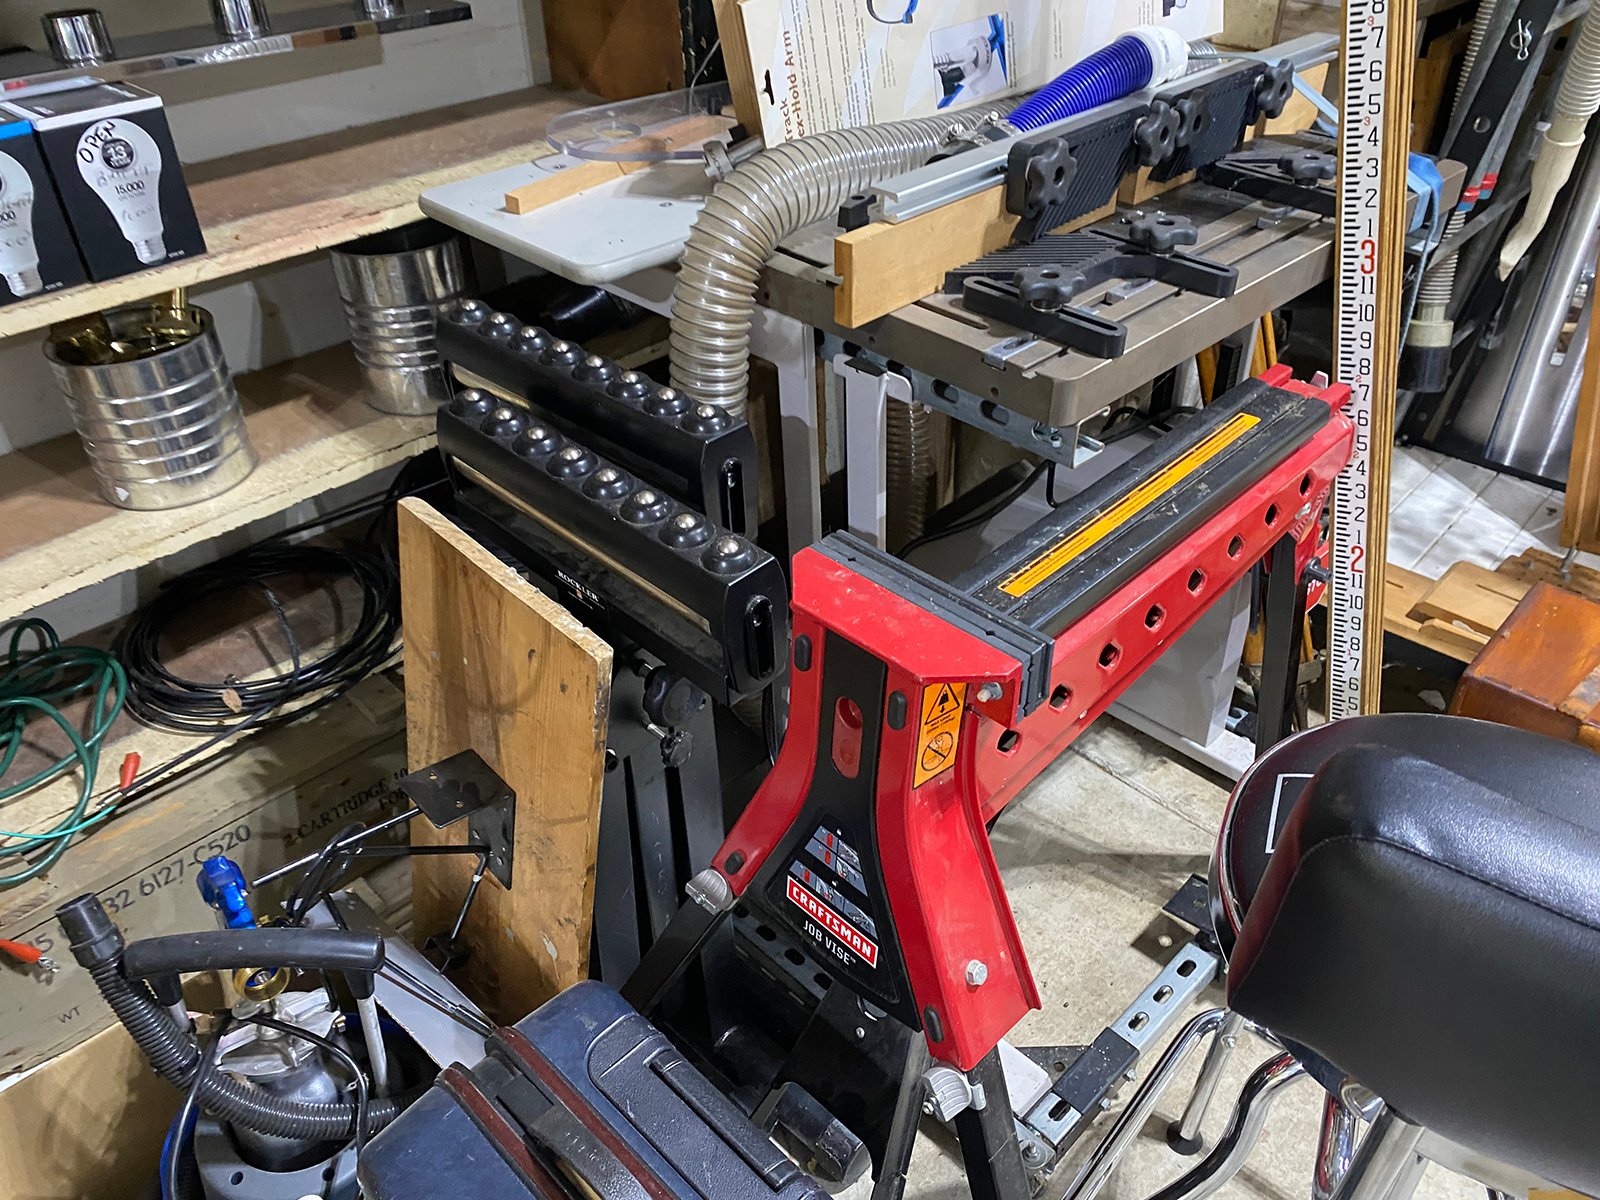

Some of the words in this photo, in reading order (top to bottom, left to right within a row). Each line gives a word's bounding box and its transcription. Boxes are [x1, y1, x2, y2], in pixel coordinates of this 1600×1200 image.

[1371, 26, 1384, 48] 7
[783, 30, 795, 66] Arm
[1369, 60, 1382, 82] 6
[787, 73, 805, 138] ex-Hold
[1368, 93, 1381, 115] 5
[78, 120, 117, 164] OPEN
[1367, 126, 1379, 147] 4
[1366, 157, 1379, 178] 3
[1365, 188, 1377, 208] 2
[1367, 218, 1373, 237] 1
[1361, 239, 1375, 274] 3
[1361, 276, 1374, 294] 11
[1359, 304, 1374, 322] 10
[1360, 331, 1372, 349] 9
[1359, 358, 1370, 375] 8
[1359, 384, 1370, 401] 7
[1357, 409, 1368, 427] 6
[1356, 434, 1367, 451] 5
[1356, 460, 1366, 476] 4
[1355, 483, 1366, 499] 3
[1354, 506, 1365, 522] 2
[1356, 529, 1361, 544] 1
[1351, 545, 1364, 573] 2
[1352, 573, 1363, 589] 11
[1349, 594, 1363, 610] 10
[1351, 616, 1361, 631] 9
[1350, 637, 1360, 651] 8
[1349, 657, 1360, 671] 7
[1348, 677, 1359, 691] 6
[1348, 696, 1358, 711] 5
[792, 885, 872, 958] CRAFTSMAN
[803, 919, 823, 943] JOB
[57, 1004, 81, 1024] WT
